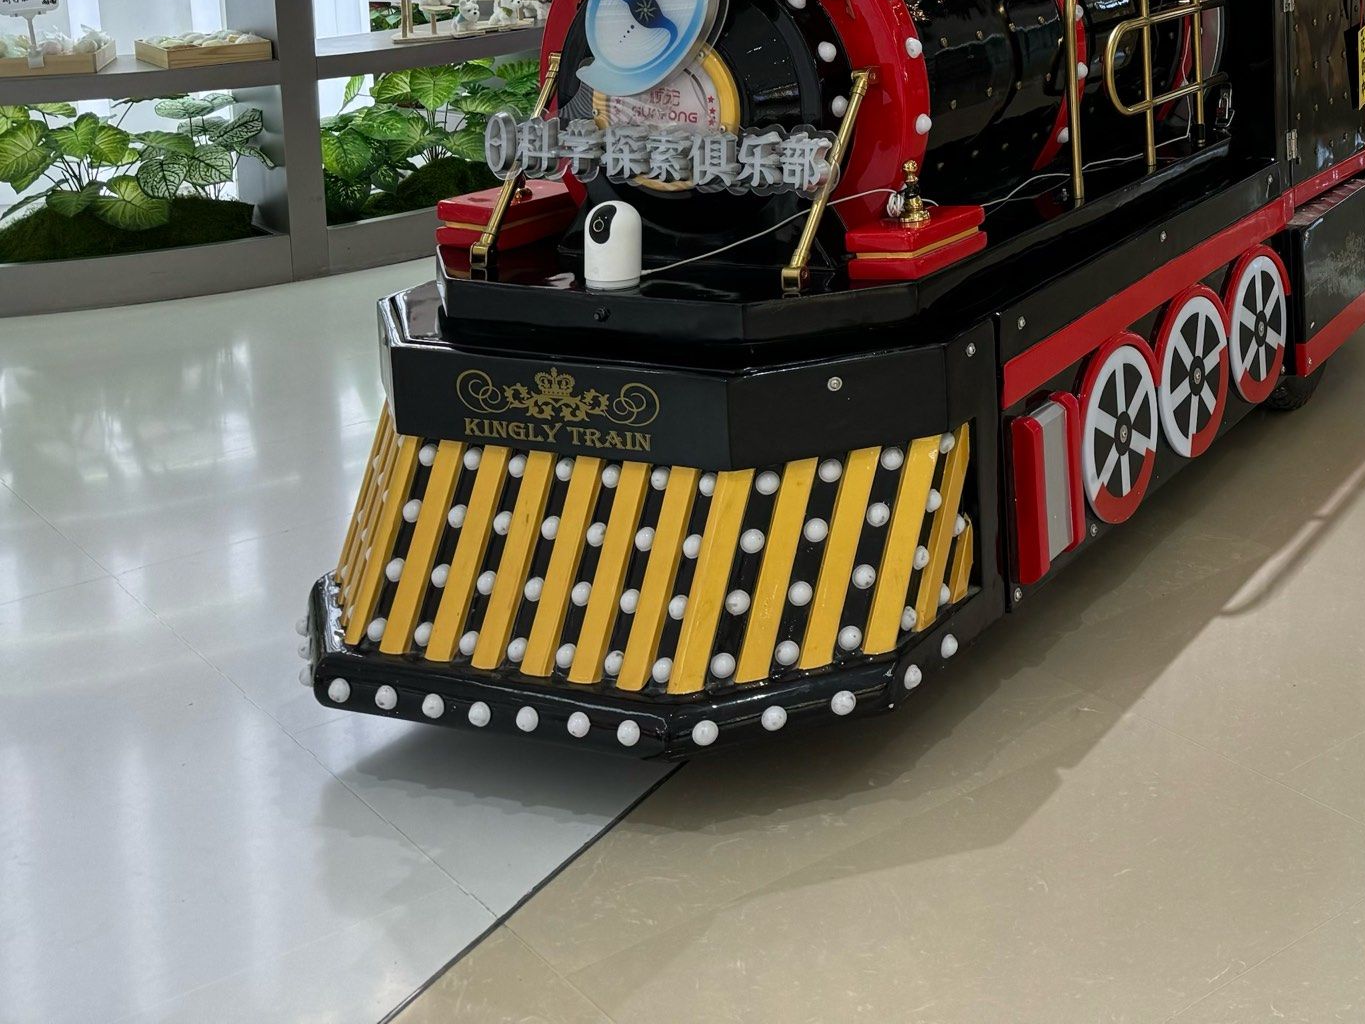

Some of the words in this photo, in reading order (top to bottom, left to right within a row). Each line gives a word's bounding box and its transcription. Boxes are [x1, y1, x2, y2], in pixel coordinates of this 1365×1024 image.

[515, 118, 836, 190] 科学探索俱乐部
[464, 417, 563, 443] KINGLY
[566, 426, 652, 452] TRAIN
